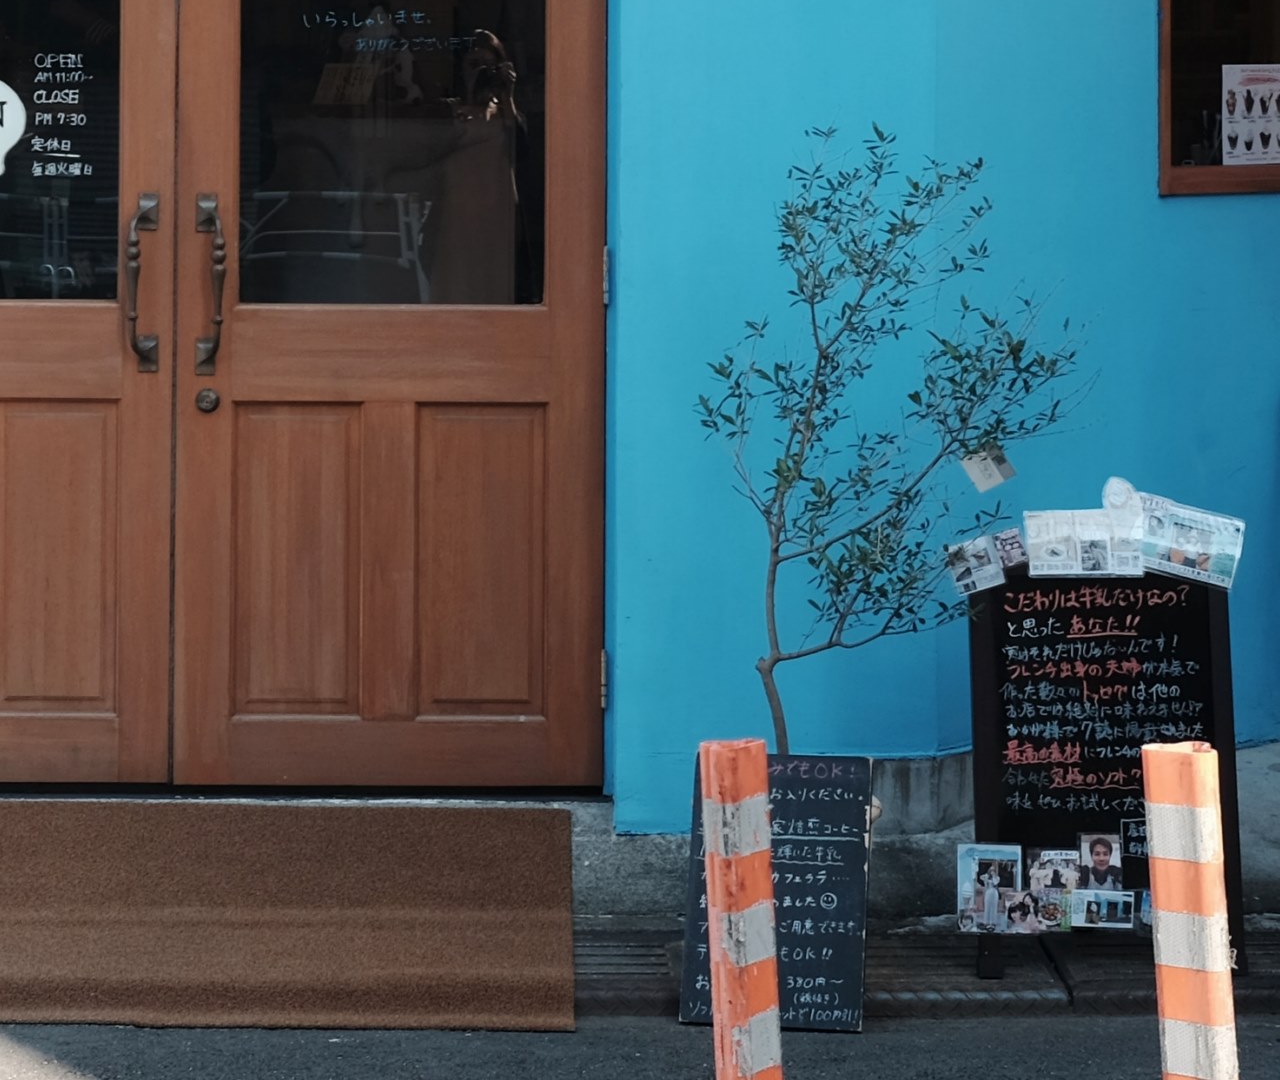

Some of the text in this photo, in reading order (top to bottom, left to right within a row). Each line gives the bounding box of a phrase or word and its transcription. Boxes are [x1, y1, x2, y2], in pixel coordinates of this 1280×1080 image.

[33, 52, 84, 69] OPEN
[33, 89, 80, 104] CLOSE
[31, 135, 72, 152] 定休日
[31, 160, 94, 177] 毎週火曜日
